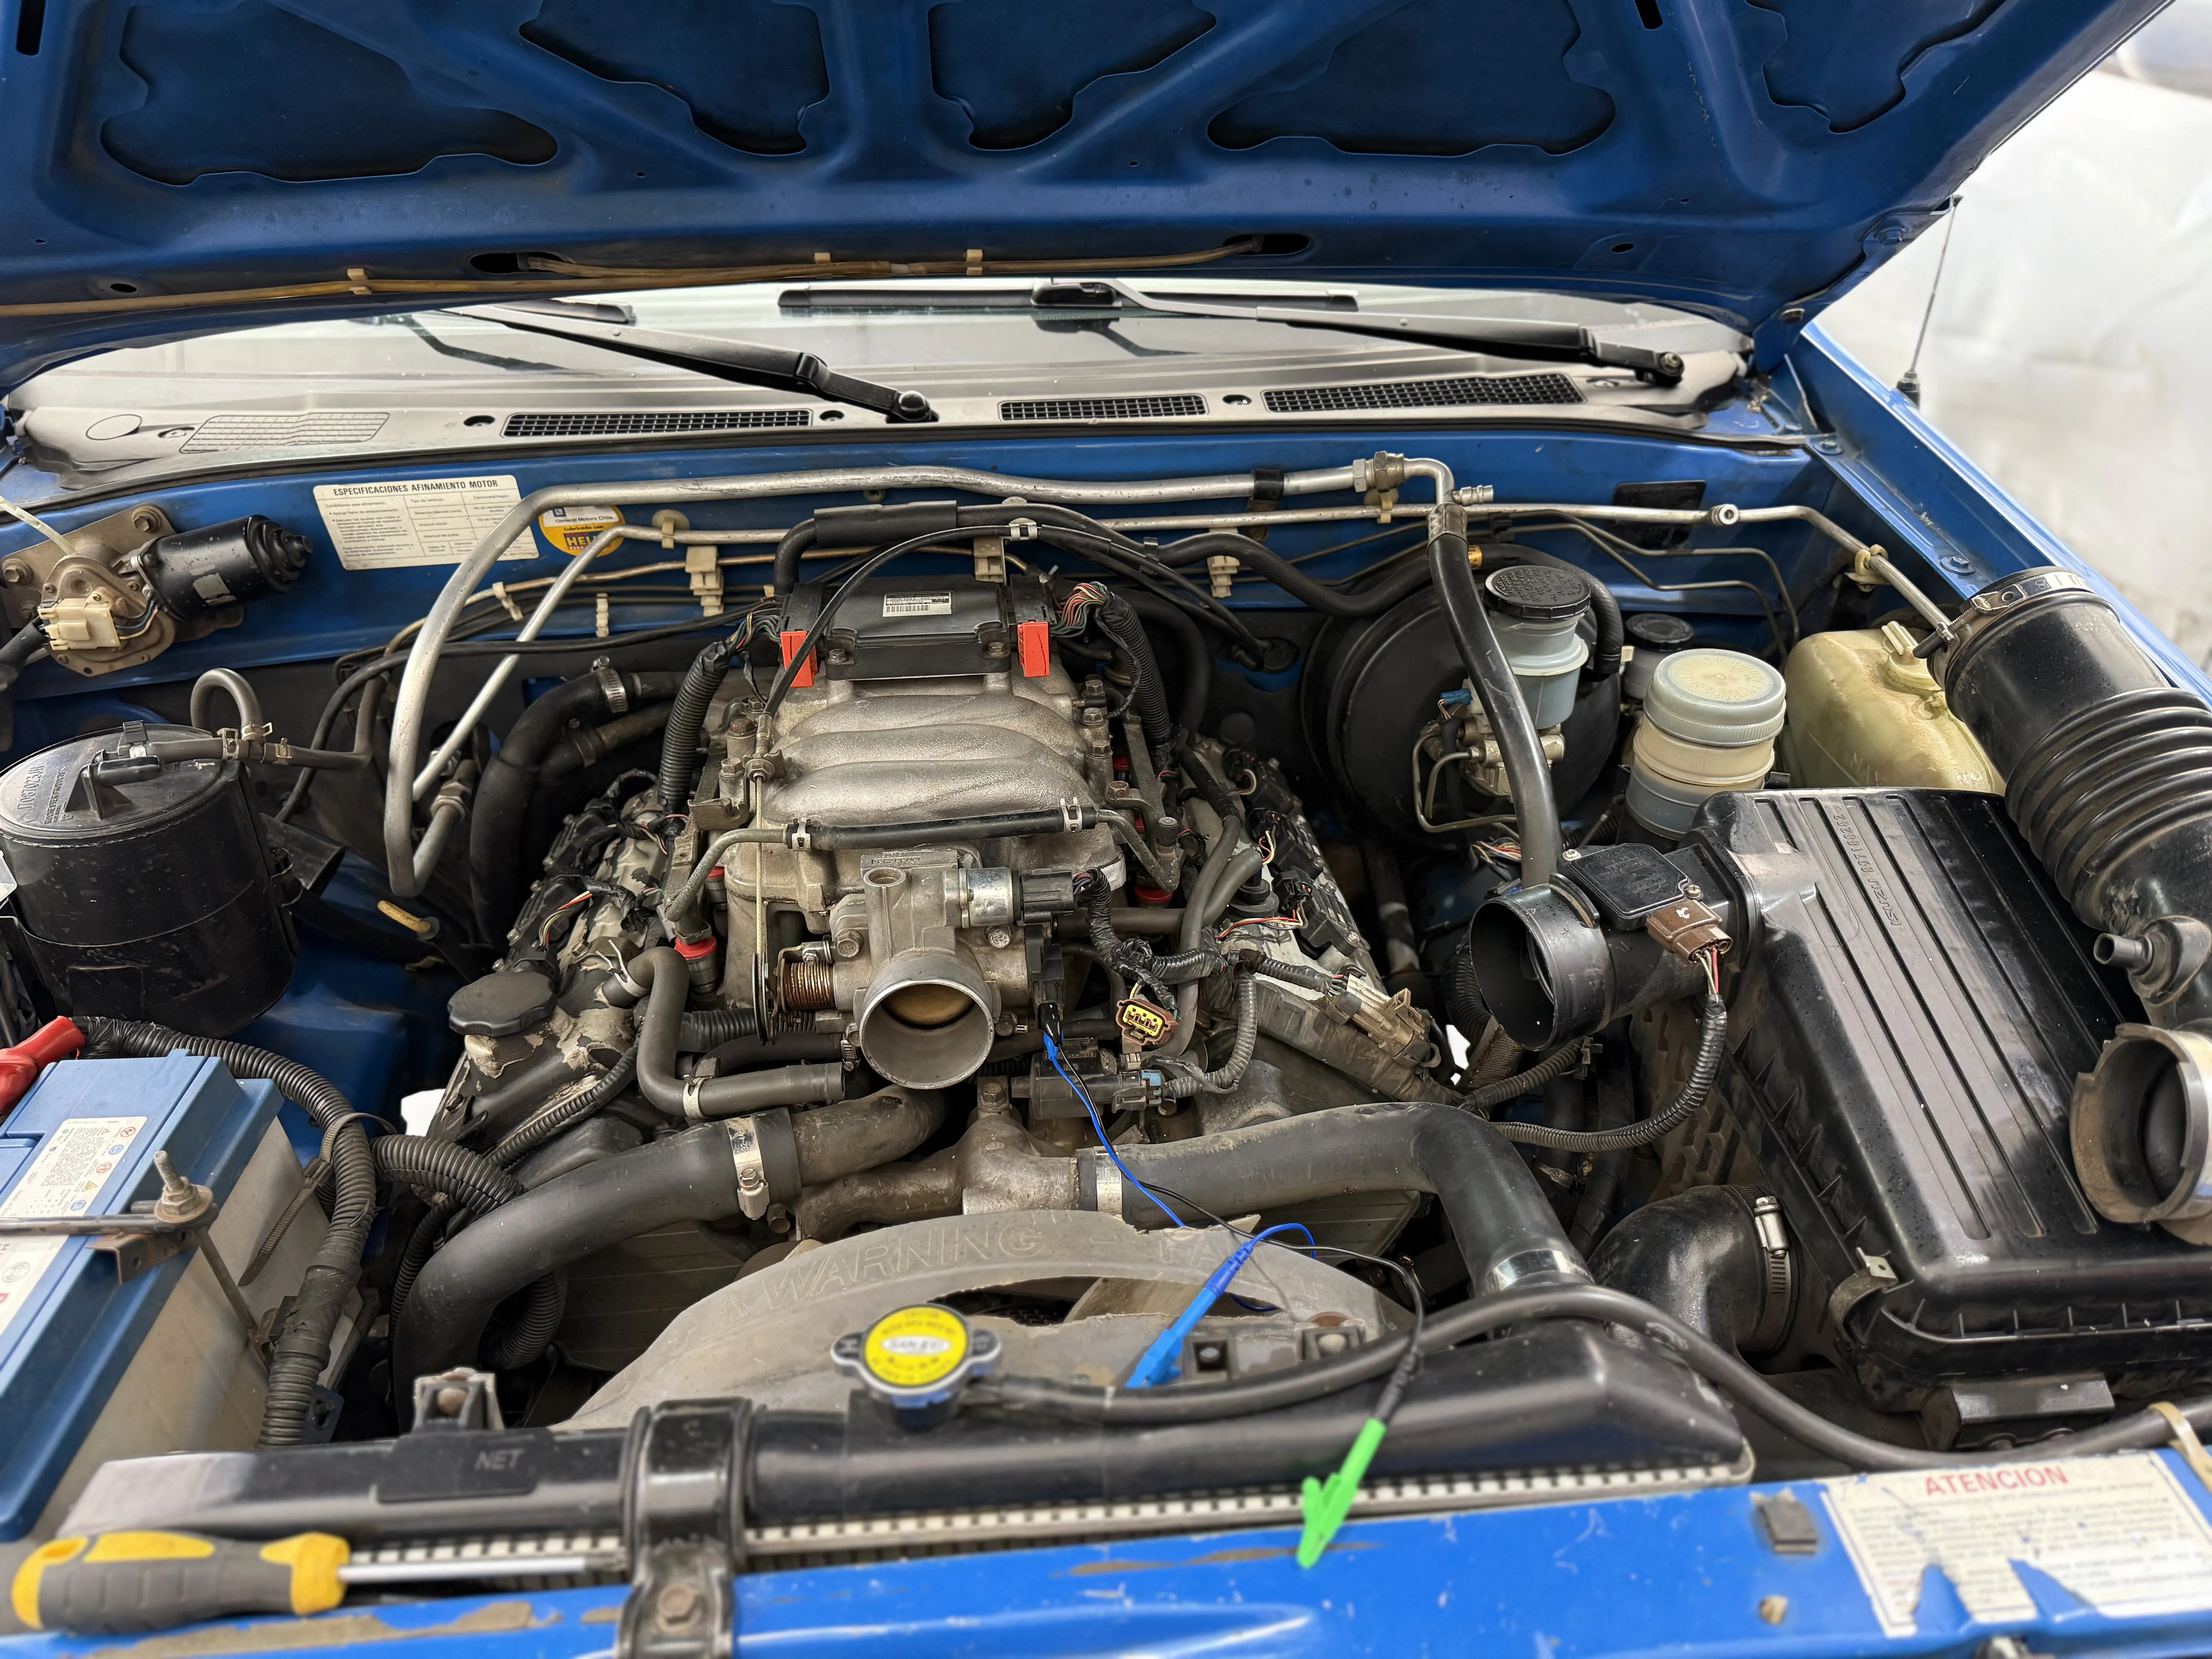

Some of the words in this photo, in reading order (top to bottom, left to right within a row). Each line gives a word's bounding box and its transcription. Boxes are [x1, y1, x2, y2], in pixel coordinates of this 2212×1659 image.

[333, 485, 408, 496] ESPECIFICACIONES
[412, 481, 465, 492] AFINAMIENTO
[470, 480, 498, 488] MOTOR
[1499, 575, 1518, 597] container
[1833, 813, 1874, 873] 897188282
[1867, 878, 1902, 926] ISUZU
[738, 1125, 749, 1151] 32-44mm
[761, 1224, 1048, 1311] WARNING
[474, 1449, 526, 1471] NET
[1925, 1465, 2069, 1496] ATENCION
